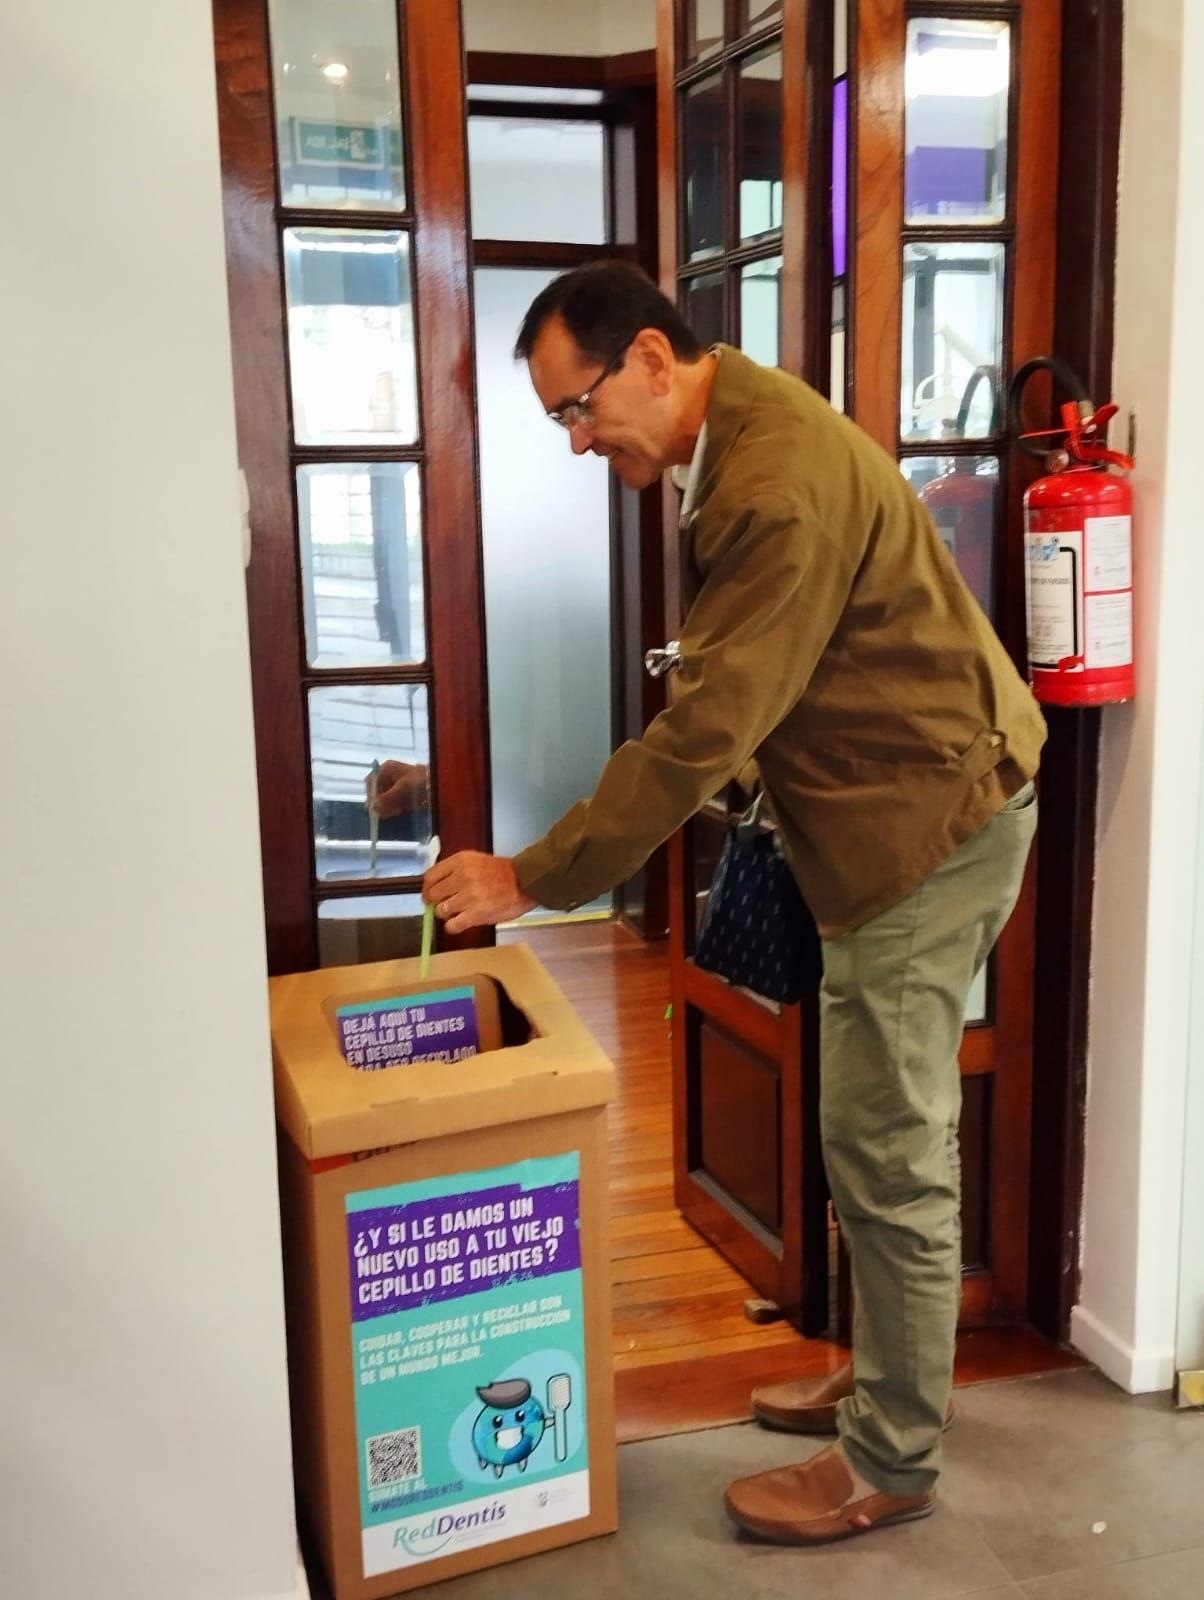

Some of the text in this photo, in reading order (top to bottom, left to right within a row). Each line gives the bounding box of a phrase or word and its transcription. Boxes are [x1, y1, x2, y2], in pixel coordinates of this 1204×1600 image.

[343, 1006, 426, 1035] DEJÁ AQUÍ TU
[344, 1016, 465, 1050] CEPILLO DE DIENTES
[346, 1052, 365, 1067] EN
[366, 1041, 413, 1063] DESUSO
[353, 1196, 534, 1257] ¿Y SI LE DAMOS UN
[357, 1216, 564, 1278] NUEVO USO A TU VIEJO
[358, 1269, 436, 1305] CEPILLO
[441, 1262, 465, 1286] DE
[408, 1313, 469, 1342] COOPERAR
[471, 1313, 481, 1327] Y
[482, 1301, 538, 1324] RECICLAR
[539, 1295, 562, 1311] SON
[359, 1352, 385, 1370] LAS
[386, 1340, 435, 1366] CLAVES
[436, 1331, 468, 1355] PARA
[471, 1328, 488, 1344] LA
[360, 1369, 377, 1387] DE
[379, 1365, 397, 1381] UN
[398, 1354, 439, 1377] MUNDO
[392, 1500, 508, 1550] RedDentis
